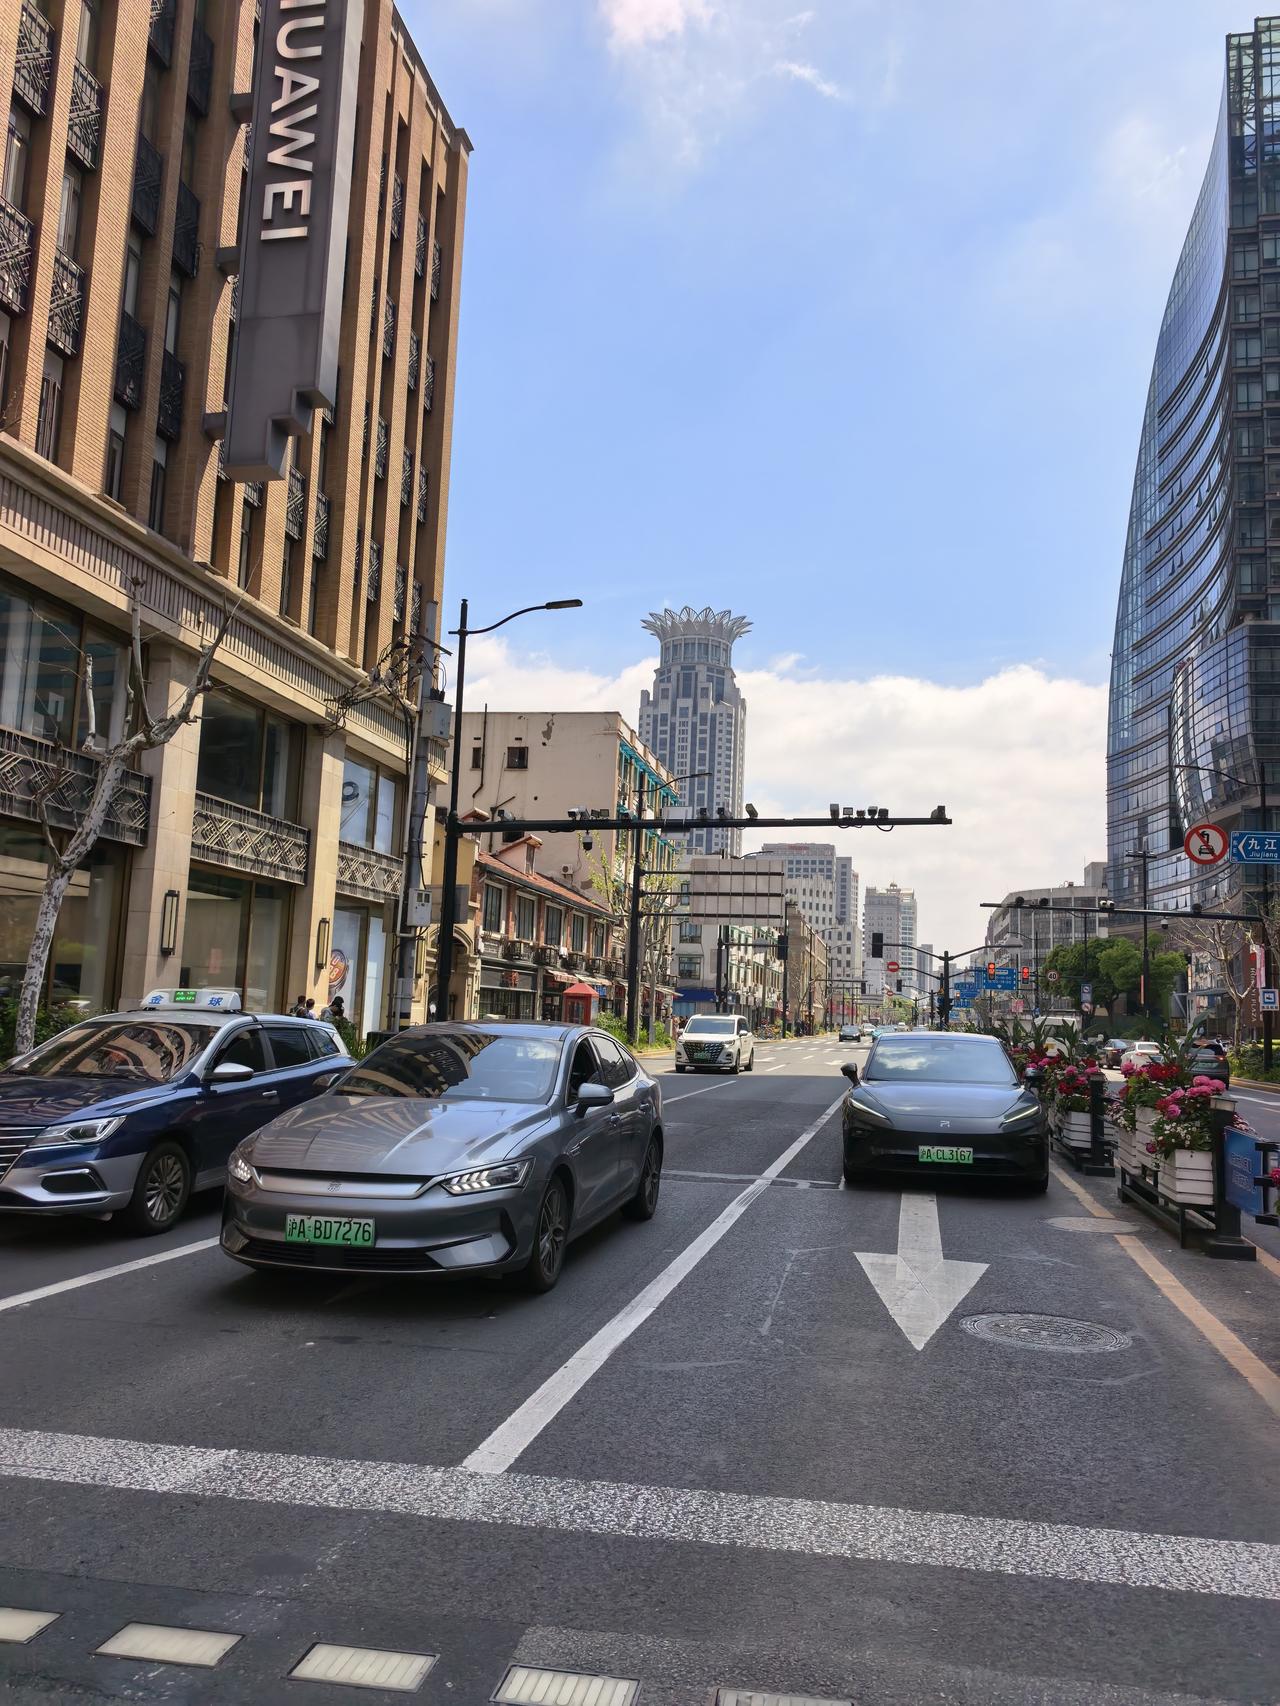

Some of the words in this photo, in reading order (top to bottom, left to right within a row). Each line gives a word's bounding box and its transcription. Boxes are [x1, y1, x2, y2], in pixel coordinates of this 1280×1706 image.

[260, 0, 327, 241] UAWEI
[1248, 837, 1277, 850] 九江
[1250, 851, 1279, 859] Jiujiang
